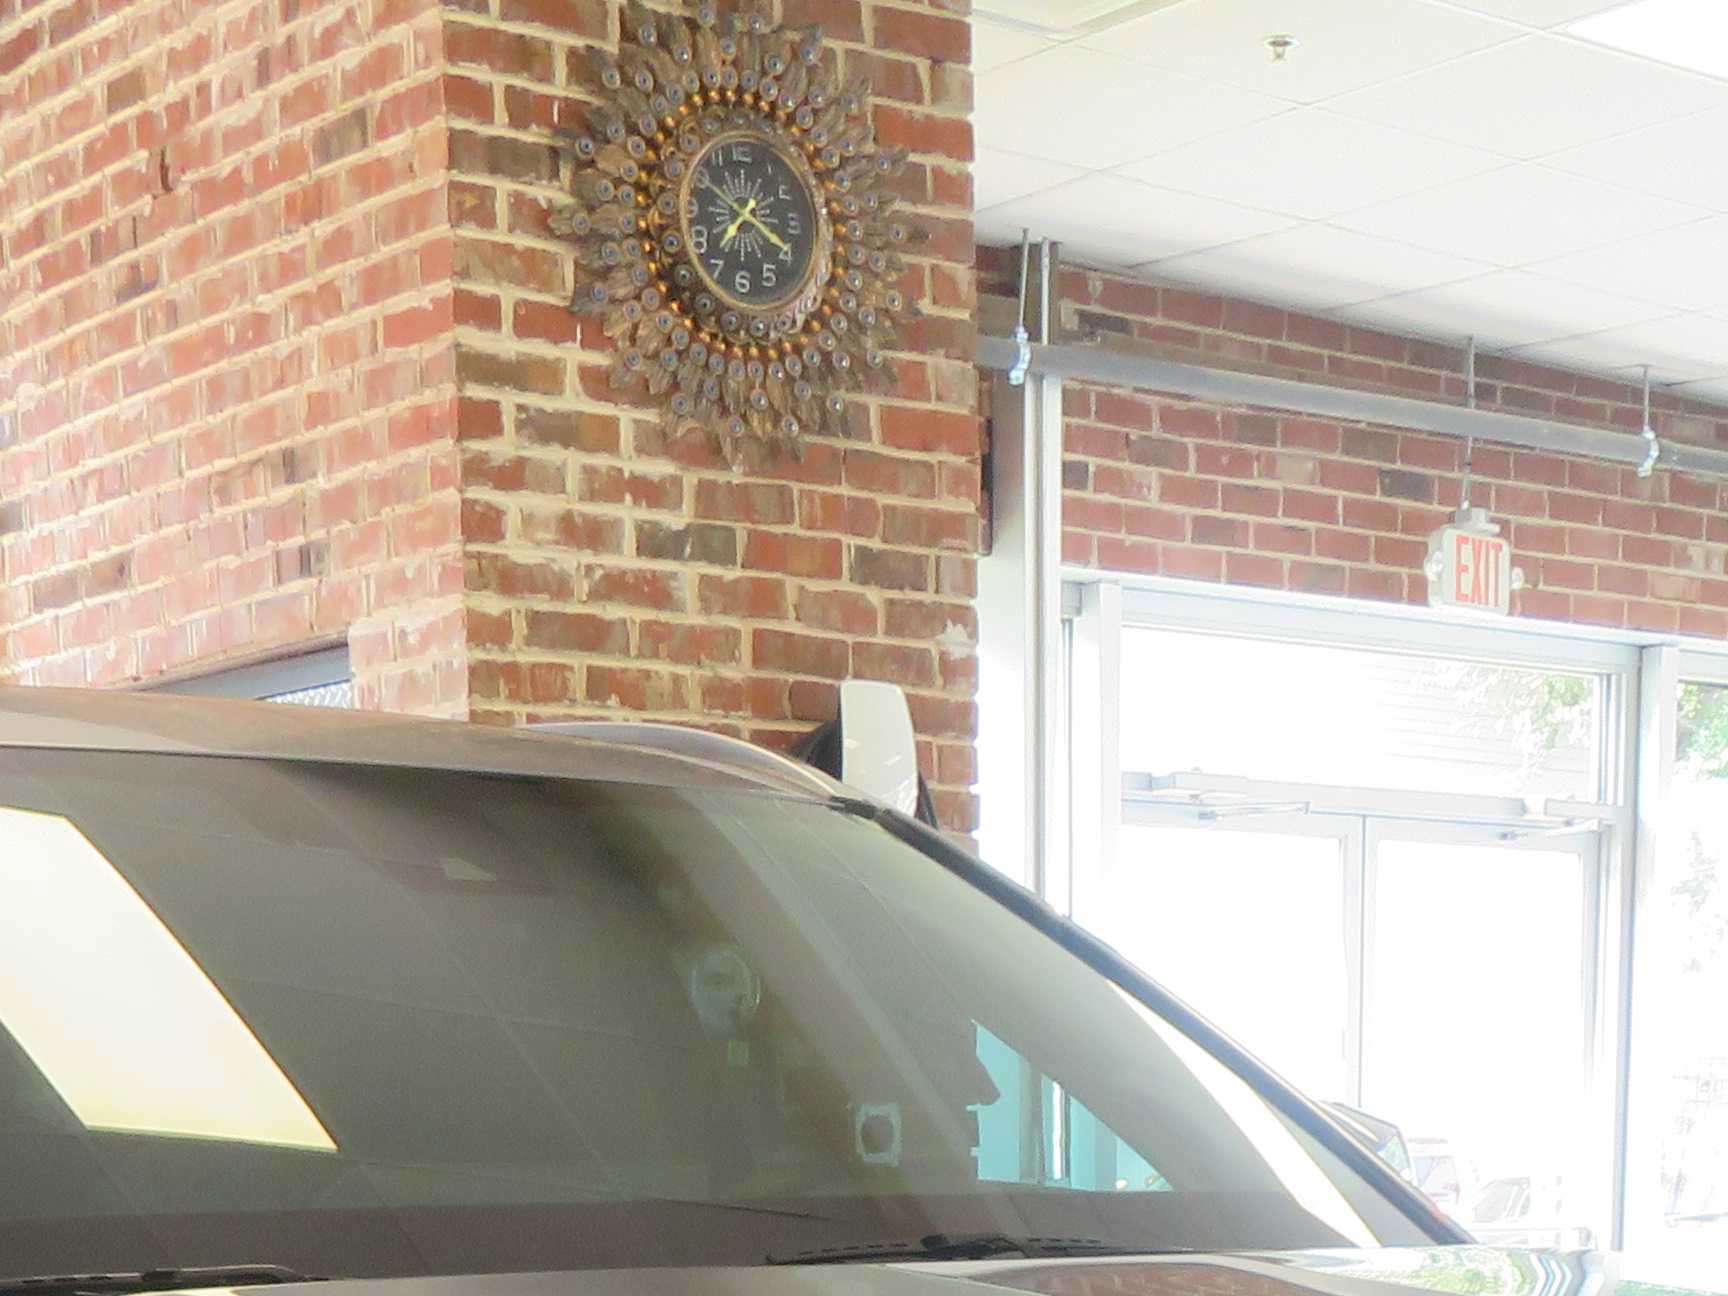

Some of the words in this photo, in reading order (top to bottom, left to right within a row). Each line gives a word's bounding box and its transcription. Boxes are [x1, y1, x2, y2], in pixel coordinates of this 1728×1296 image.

[692, 226, 708, 254] 8
[778, 243, 794, 266] 4
[710, 259, 725, 280] 7
[762, 263, 777, 288] 5
[735, 270, 751, 294] 6
[1456, 535, 1503, 607] EXIT
